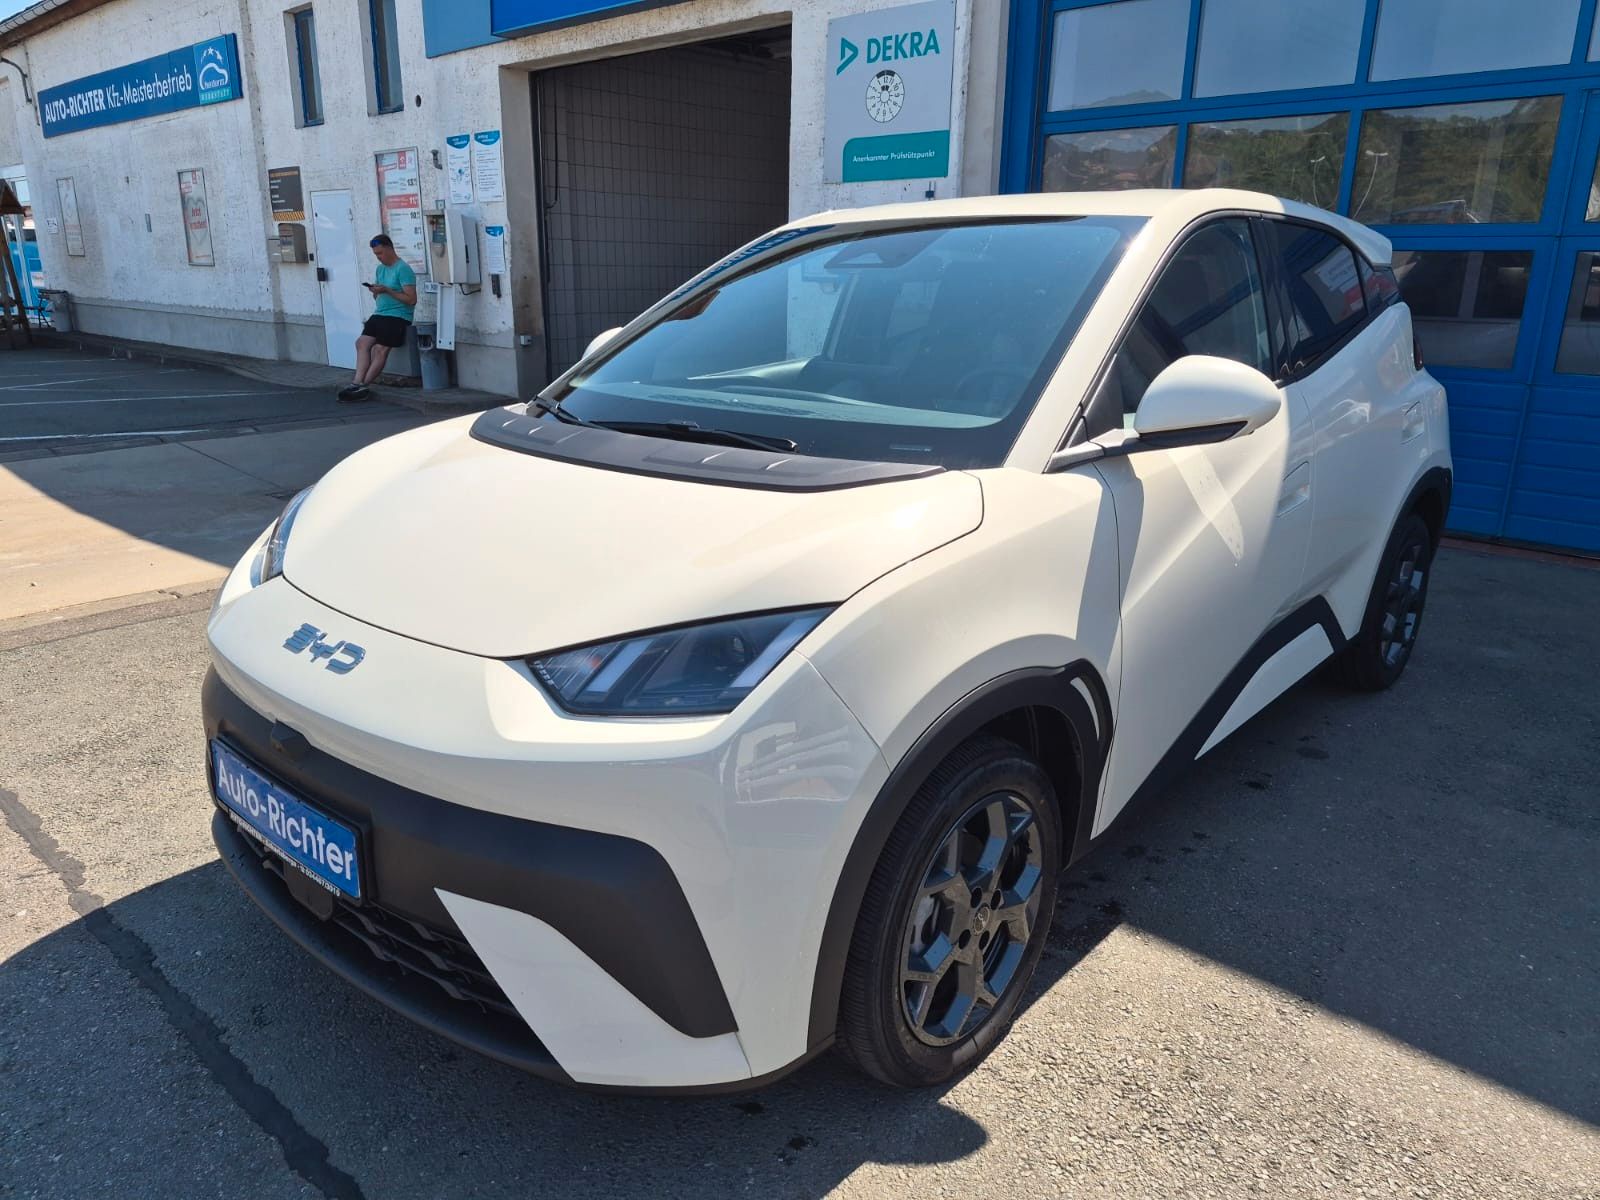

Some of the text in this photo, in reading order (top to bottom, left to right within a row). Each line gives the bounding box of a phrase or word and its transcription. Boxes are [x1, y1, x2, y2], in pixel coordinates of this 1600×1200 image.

[866, 28, 940, 64] DEKRA
[45, 65, 192, 124] AUTO-RICHTER Kfz-Meisterbetrieb
[853, 149, 935, 163] Anerkannter Prüfstützpunkt
[282, 622, 366, 675] BYD
[218, 758, 353, 881] Auto-Richter
